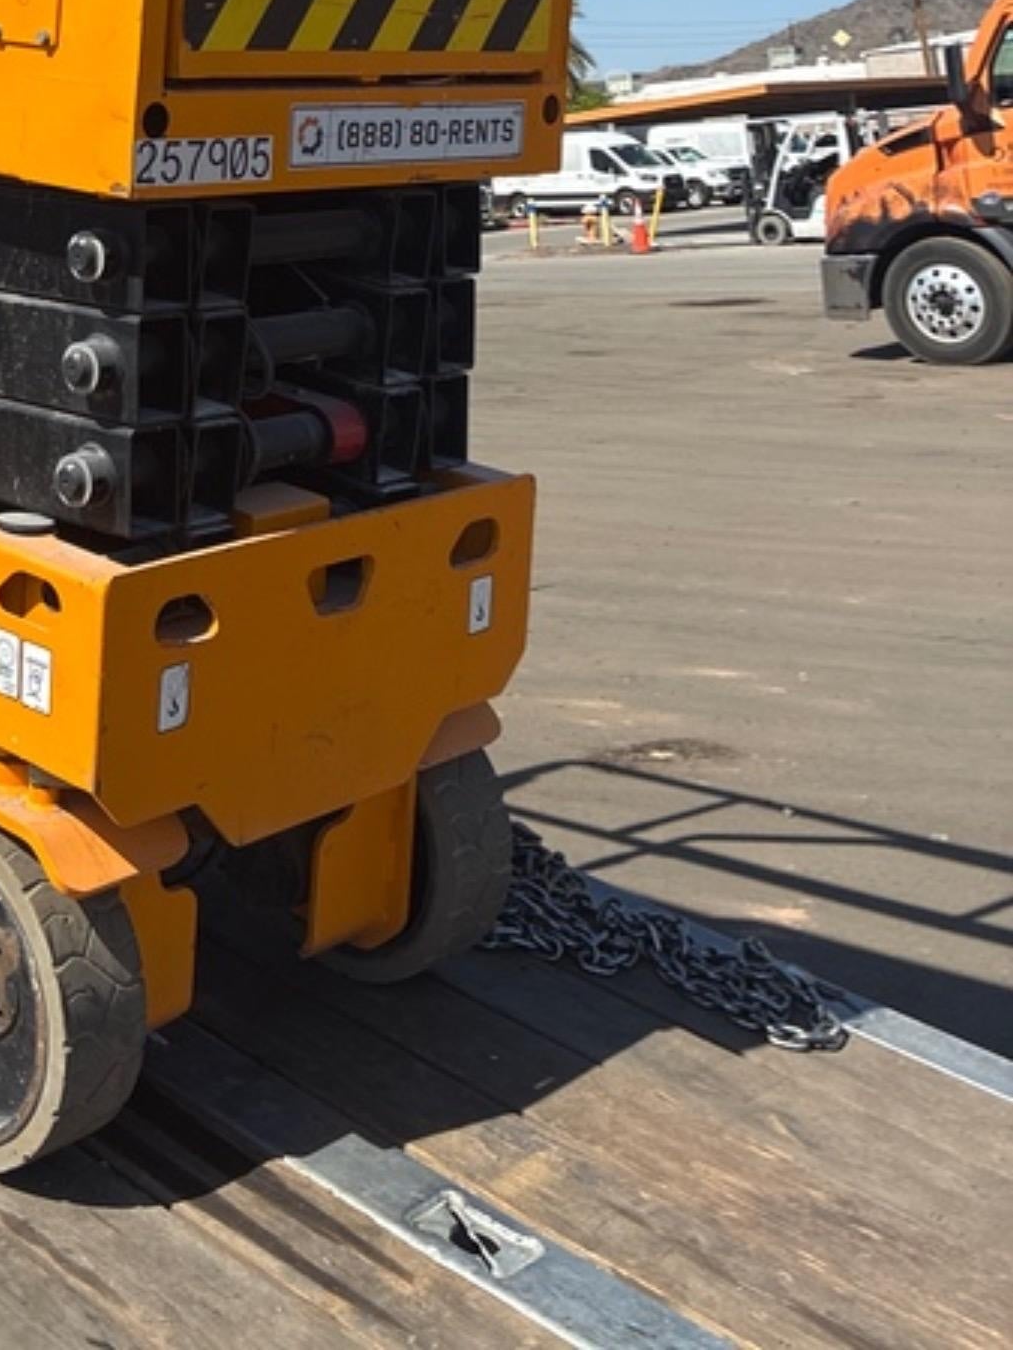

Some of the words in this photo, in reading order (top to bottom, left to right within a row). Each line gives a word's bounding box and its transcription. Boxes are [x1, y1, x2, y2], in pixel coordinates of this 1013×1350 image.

[336, 120, 403, 151] (888)
[409, 116, 515, 147] 80-RENTS
[136, 136, 271, 185] 257905
